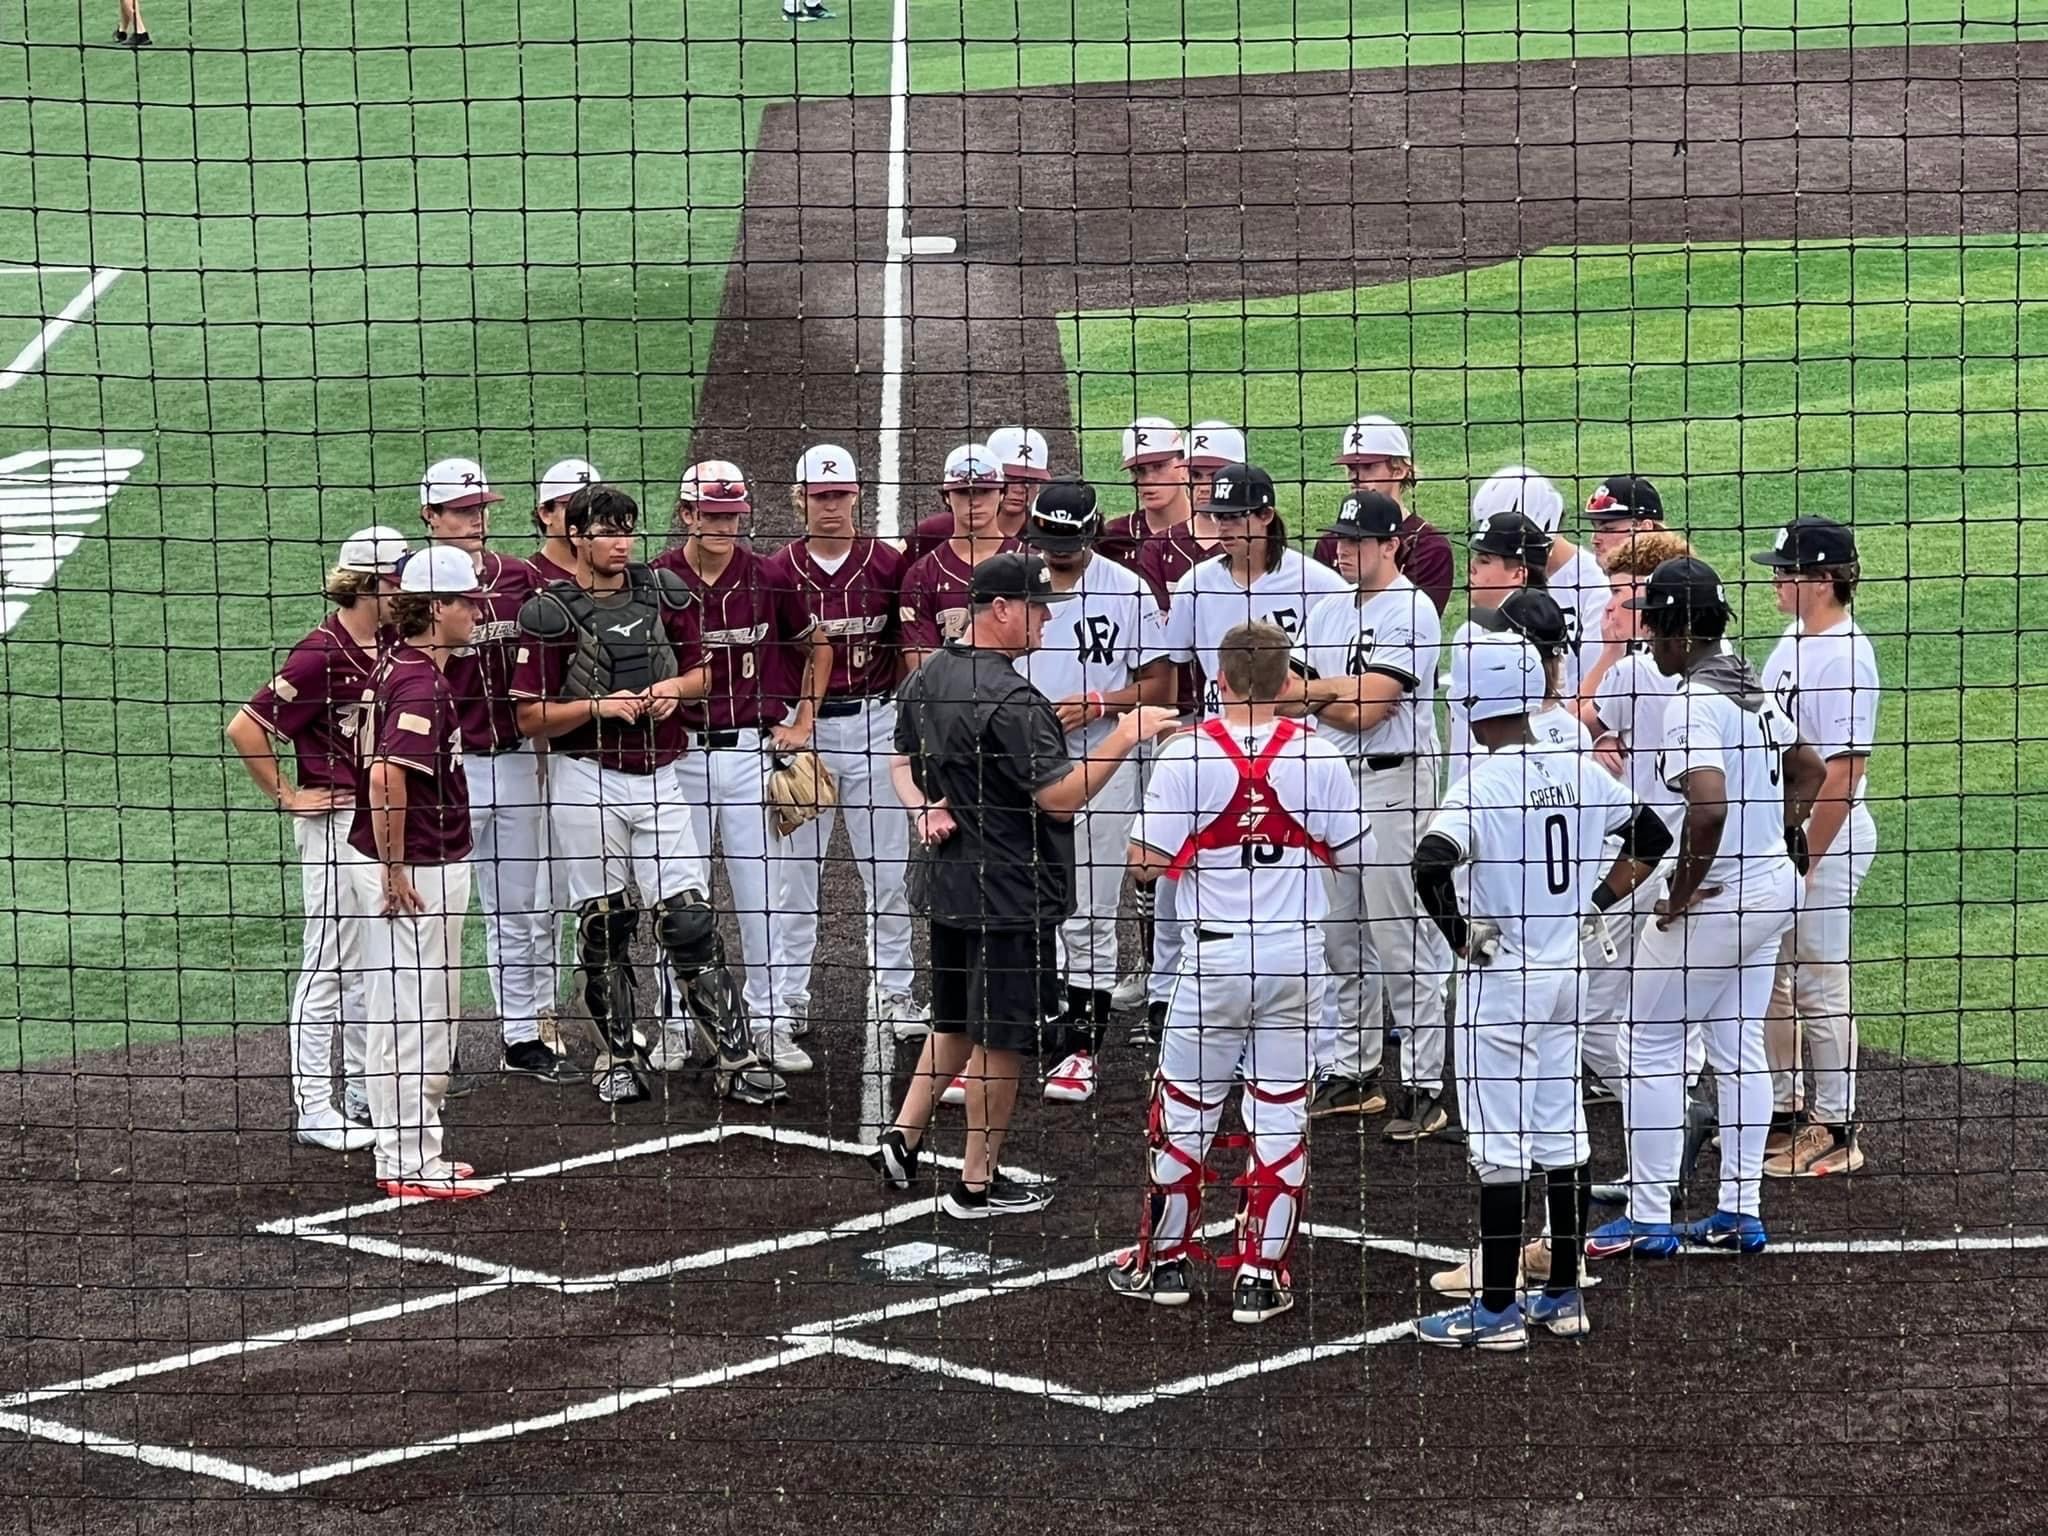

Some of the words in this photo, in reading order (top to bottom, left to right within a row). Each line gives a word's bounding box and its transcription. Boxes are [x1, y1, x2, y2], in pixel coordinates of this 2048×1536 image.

[1194, 435, 1209, 450] R
[1350, 432, 1364, 449] R
[1018, 444, 1034, 461] R
[821, 460, 839, 476] R
[742, 652, 755, 679] 8
[1530, 785, 1566, 811] GREEN
[1565, 781, 1576, 804] II
[1545, 813, 1570, 895] 0
